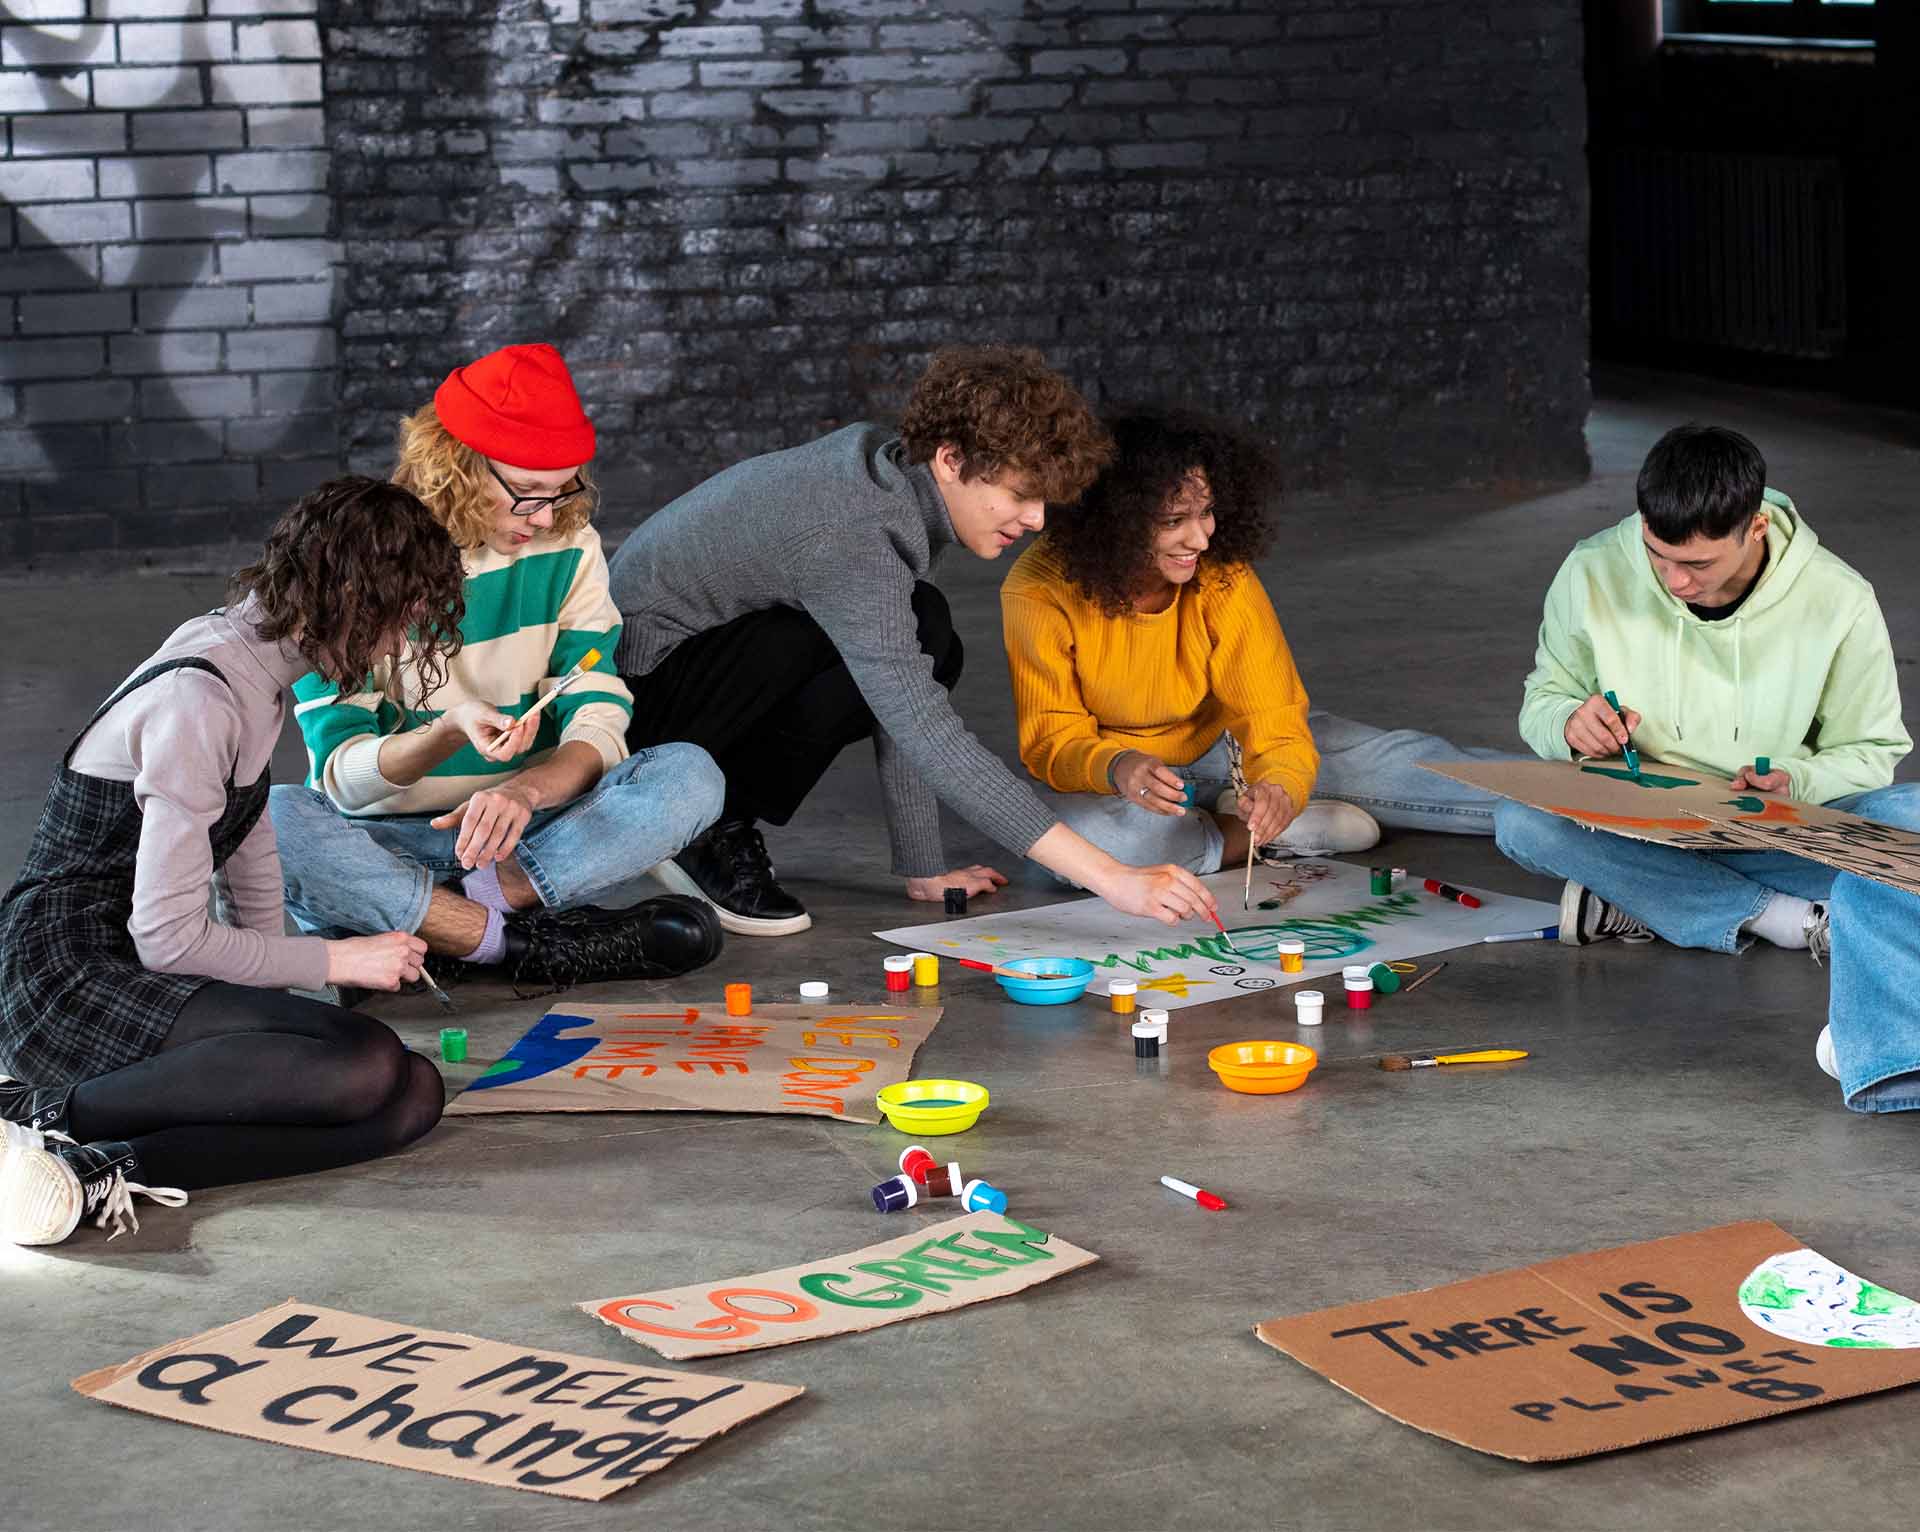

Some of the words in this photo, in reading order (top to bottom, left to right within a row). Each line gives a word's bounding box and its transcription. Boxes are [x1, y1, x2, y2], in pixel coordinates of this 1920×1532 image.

[675, 1025, 773, 1076] HAVE
[598, 1288, 818, 1340] GO
[800, 1218, 1055, 1309] GREEN
[256, 1315, 469, 1373] WE
[1331, 1308, 1587, 1367] THERE
[1598, 1282, 1693, 1320] IS
[1570, 1321, 1745, 1376] NO
[138, 1354, 267, 1404] a
[1510, 1350, 1816, 1422] PLANET
[1728, 1378, 1826, 1403] B
